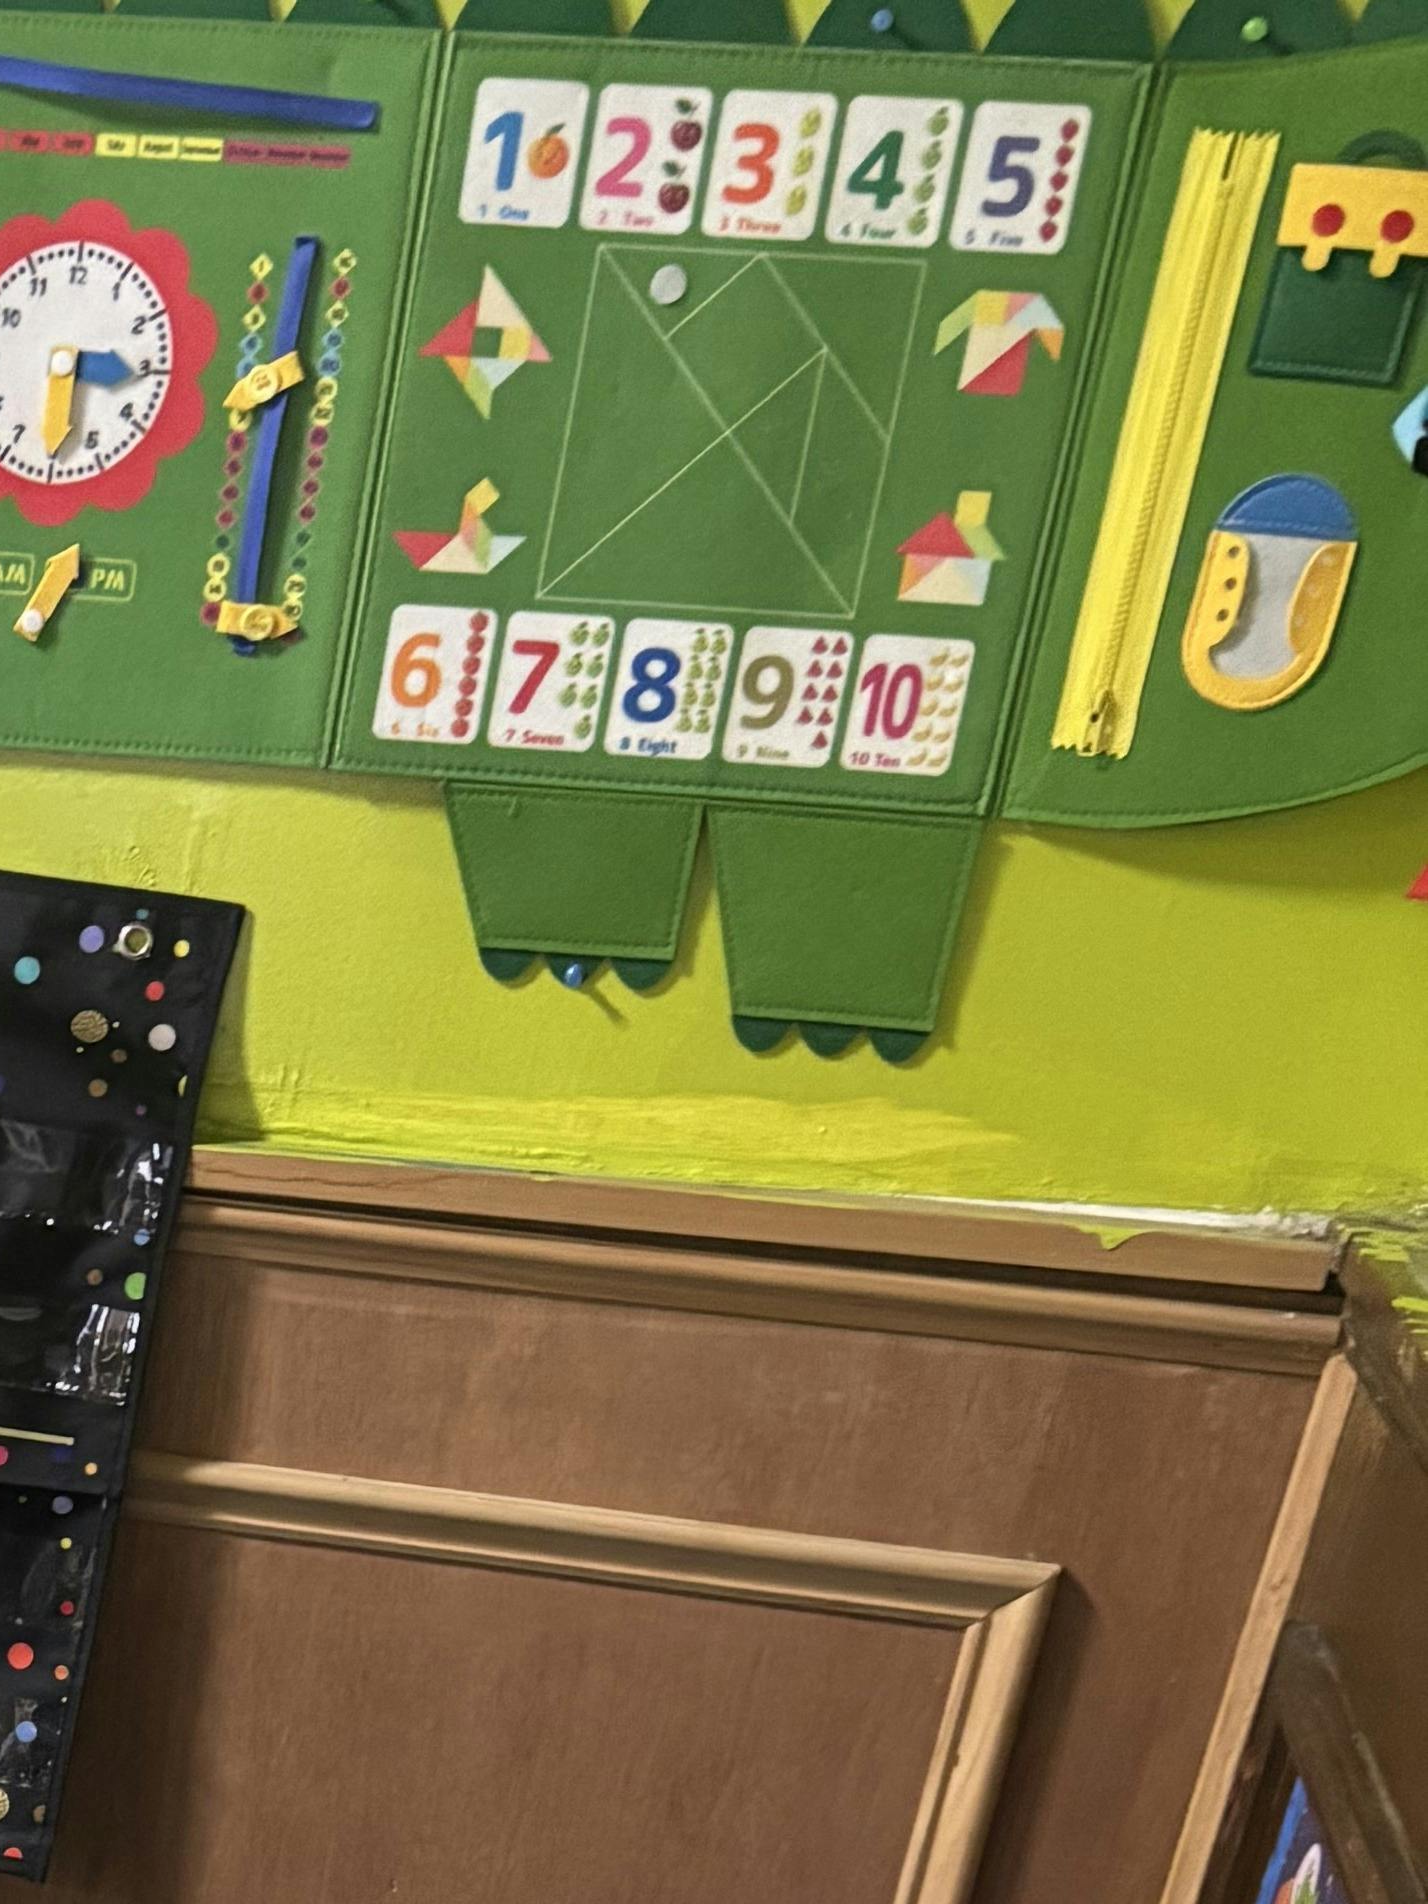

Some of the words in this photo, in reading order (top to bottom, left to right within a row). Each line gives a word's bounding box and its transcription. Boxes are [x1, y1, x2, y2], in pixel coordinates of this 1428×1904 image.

[483, 110, 524, 192] 1
[595, 116, 651, 198] 2
[721, 123, 780, 205] 3
[847, 130, 904, 210] 4
[981, 136, 1041, 218] 5
[859, 223, 896, 239] Four
[69, 266, 88, 285] 12
[30, 277, 47, 296] 11
[112, 282, 121, 301] 1
[1, 308, 21, 328] 10
[131, 316, 147, 335] 2
[119, 402, 134, 421] 4
[12, 424, 26, 444] 7
[84, 430, 99, 450] 5
[90, 568, 125, 591] PM
[391, 632, 442, 708] 6
[509, 640, 561, 715] 7
[622, 647, 681, 724] 8
[741, 655, 794, 730] 9
[861, 663, 923, 740] 10
[505, 729, 516, 742] 7
[522, 730, 565, 746] Seven
[619, 738, 630, 750] 8
[638, 737, 679, 757] Eight
[850, 751, 869, 766] 10
[874, 752, 901, 768] Ten
